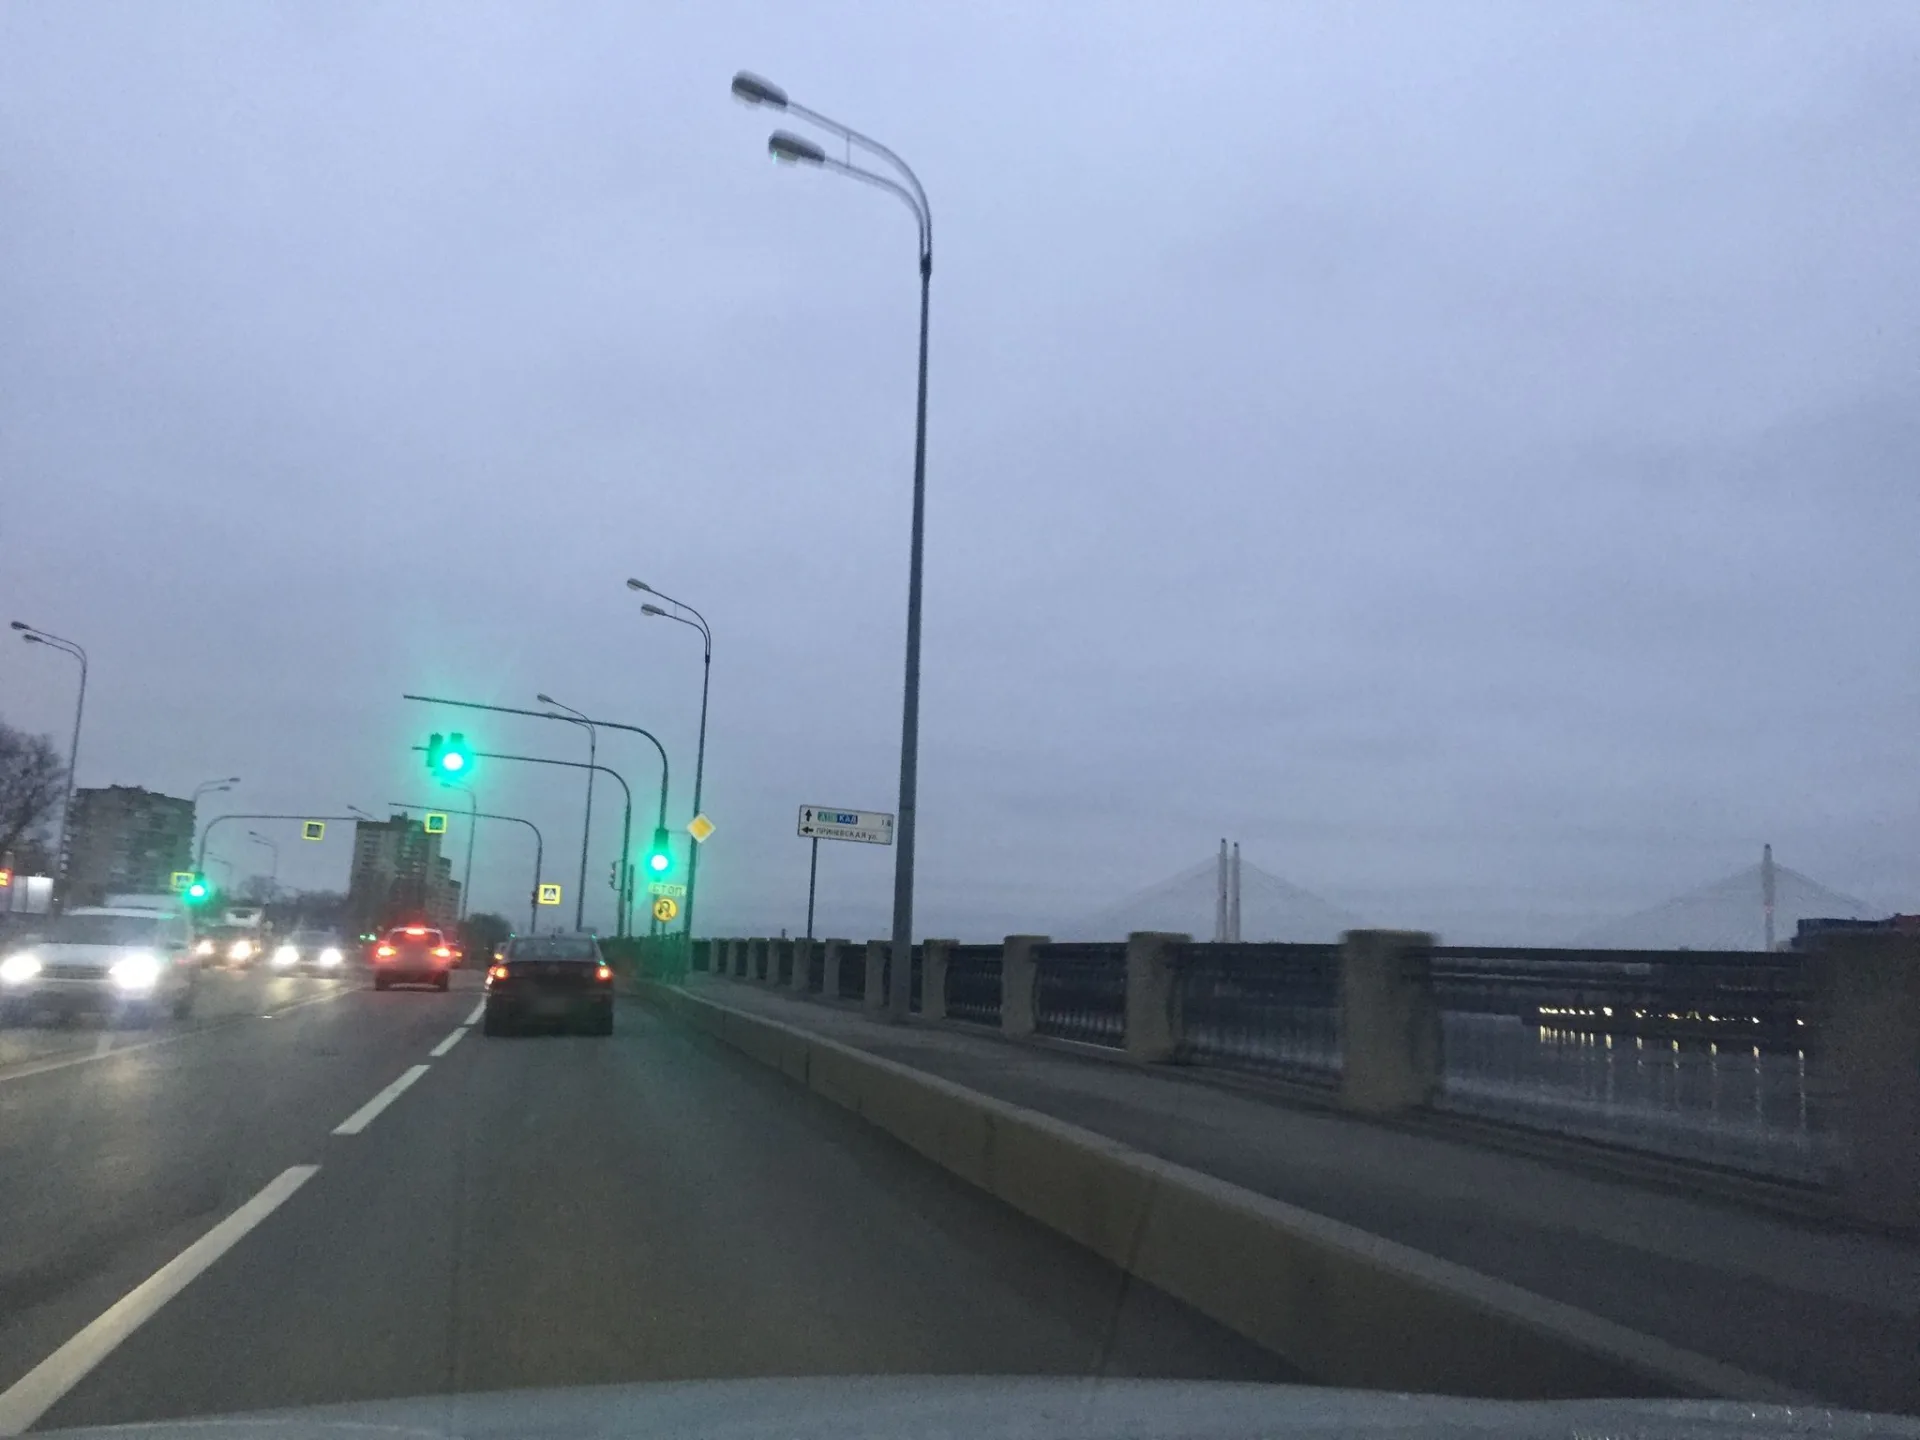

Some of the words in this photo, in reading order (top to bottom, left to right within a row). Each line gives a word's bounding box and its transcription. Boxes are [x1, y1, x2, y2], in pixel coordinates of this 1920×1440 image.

[839, 814, 857, 825] КАД
[816, 827, 866, 839] ПРИНЕВСКАЯ
[651, 884, 683, 897] СТОП
